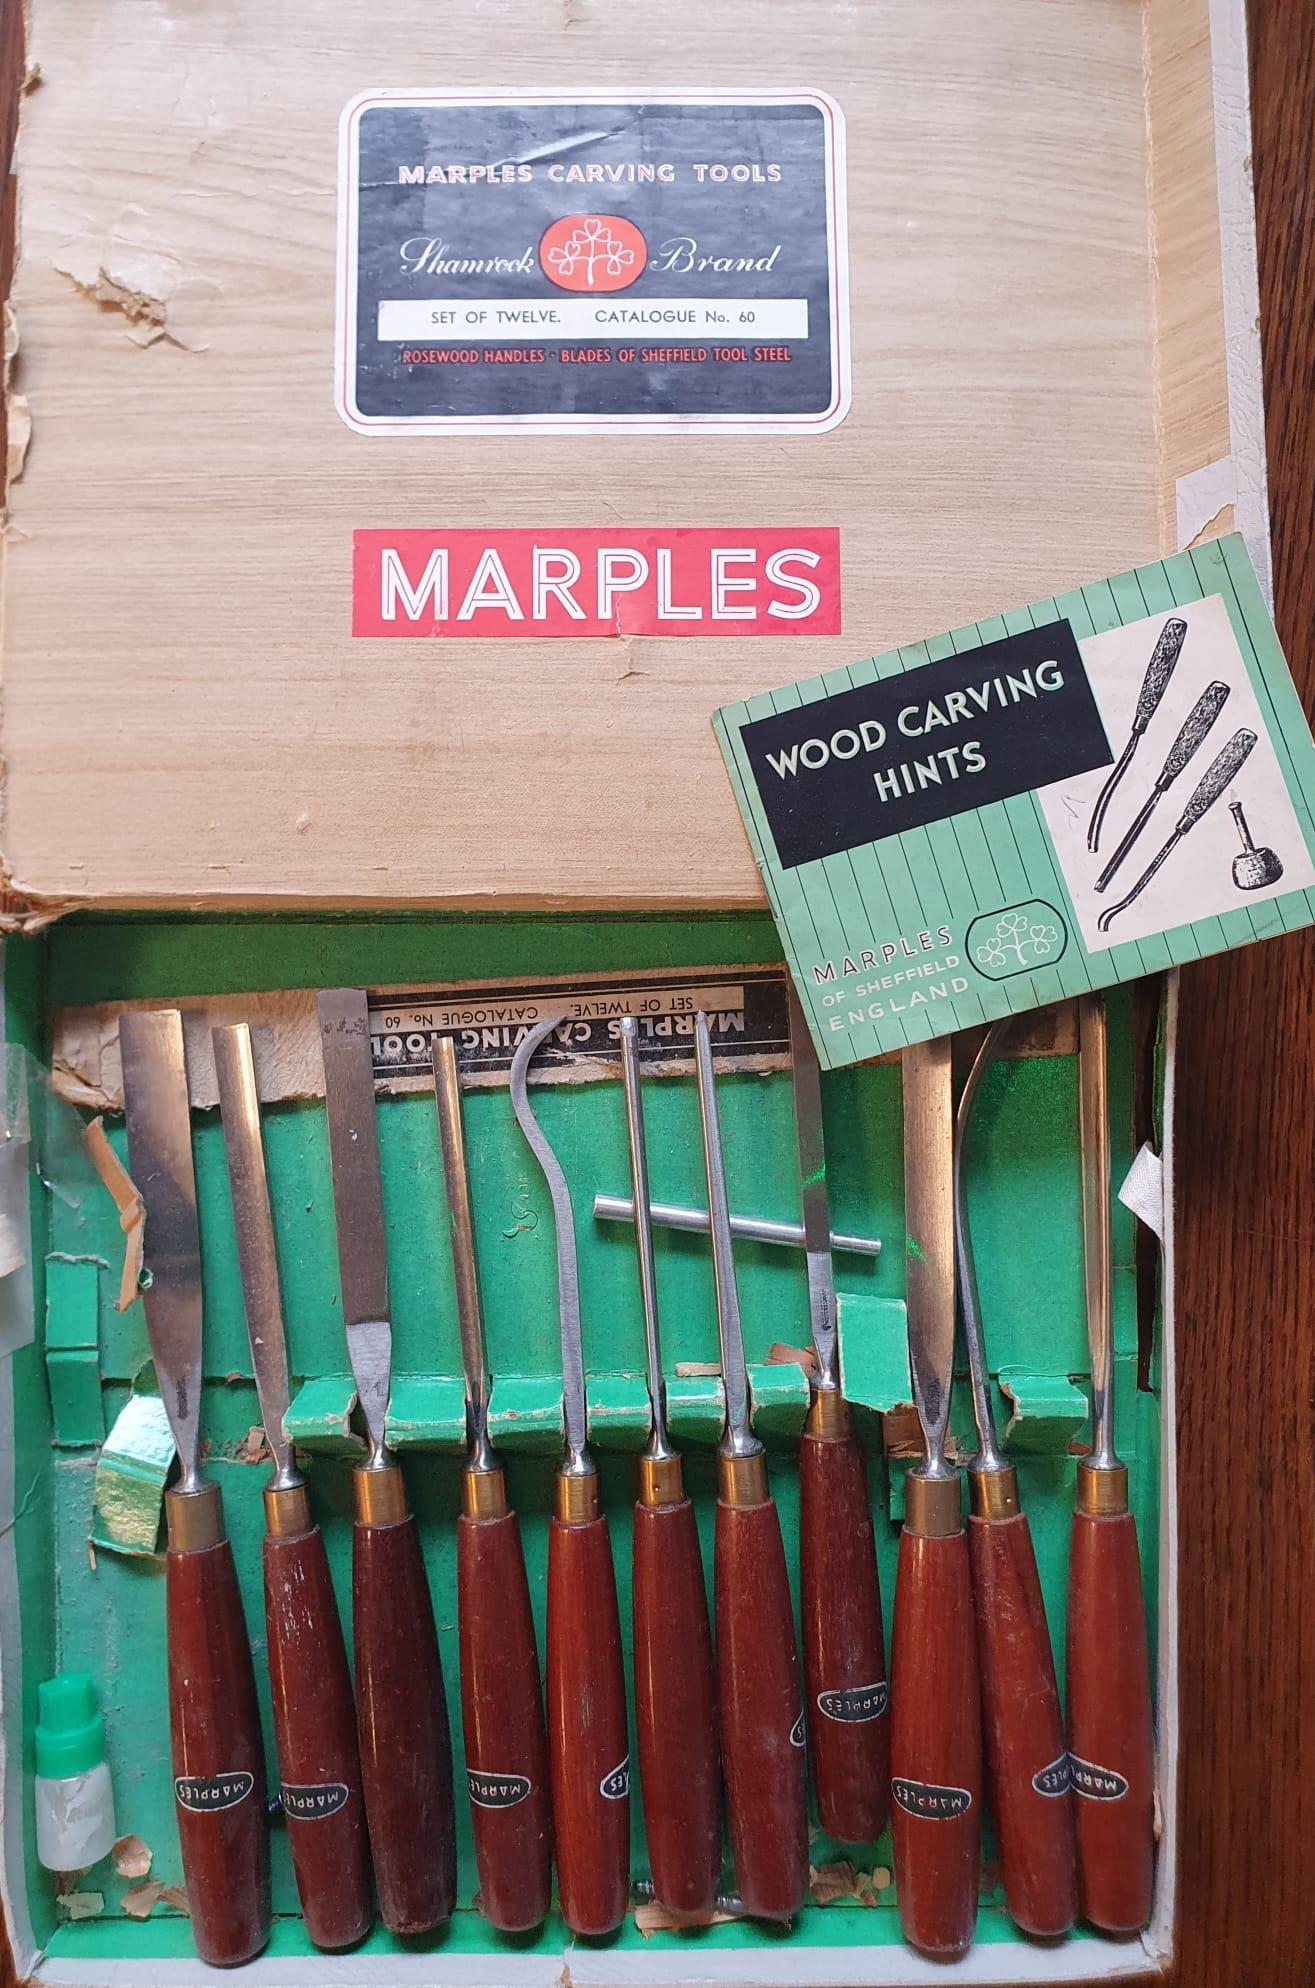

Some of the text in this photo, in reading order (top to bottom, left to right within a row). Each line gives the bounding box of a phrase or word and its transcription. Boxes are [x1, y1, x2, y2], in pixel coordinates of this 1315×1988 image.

[399, 163, 782, 184] MARPLES CARVING TOOLS
[399, 236, 781, 274] Shamrock Brand
[431, 309, 756, 325] SET OF TWELVE. CATALOGUE No. 60
[402, 346, 791, 364] ROSEWOOD HANDLES BLADES OF SHEFFIELD TOOL STEEL
[381, 547, 822, 621] MARPLES
[765, 659, 1065, 781] WOOD CARVING
[872, 740, 988, 803] HINTS
[811, 925, 953, 985] MARPLES
[822, 955, 960, 1007] OF SHEFFIELD
[570, 1001, 632, 1017] TWELVE.
[640, 999, 661, 1012] OF
[670, 997, 693, 1011] SET
[828, 977, 969, 1032] ENGLAND
[385, 1015, 401, 1029] 60
[442, 1006, 538, 1026] CATALOGUE
[461, 1020, 592, 1050] CAVING
[178, 1780, 245, 1799] MARPLES
